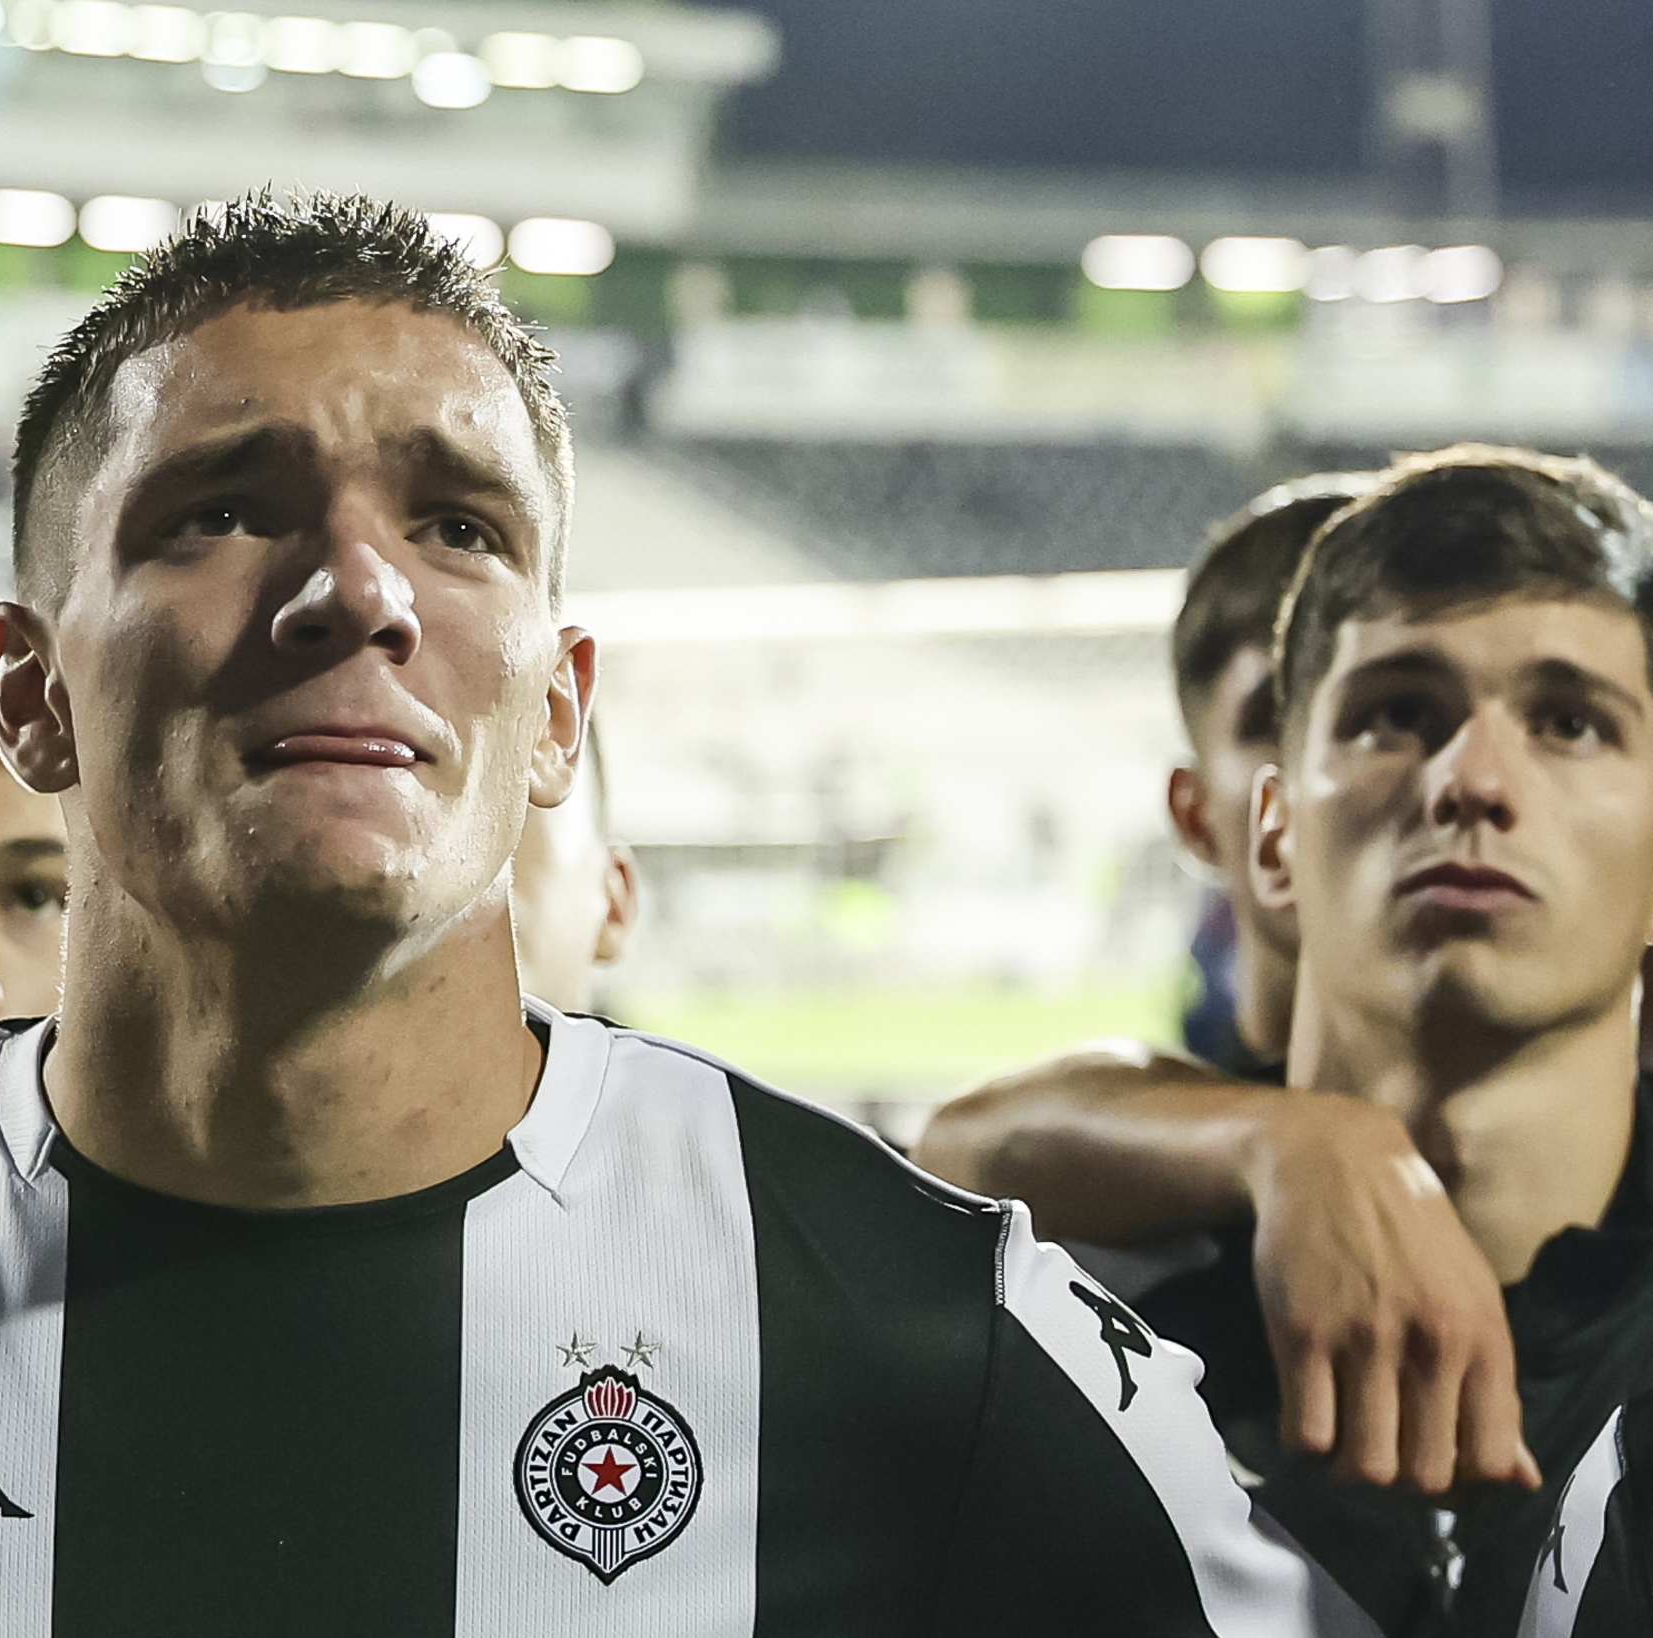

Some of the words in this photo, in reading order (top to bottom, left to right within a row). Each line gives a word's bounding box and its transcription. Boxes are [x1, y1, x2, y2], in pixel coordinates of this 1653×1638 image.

[529, 1409, 582, 1542] PARTIZAN
[561, 1428, 658, 1478] FUDBALSKI
[632, 1410, 689, 1544] ПАРТИЗАН
[576, 1495, 643, 1519] KLUB
